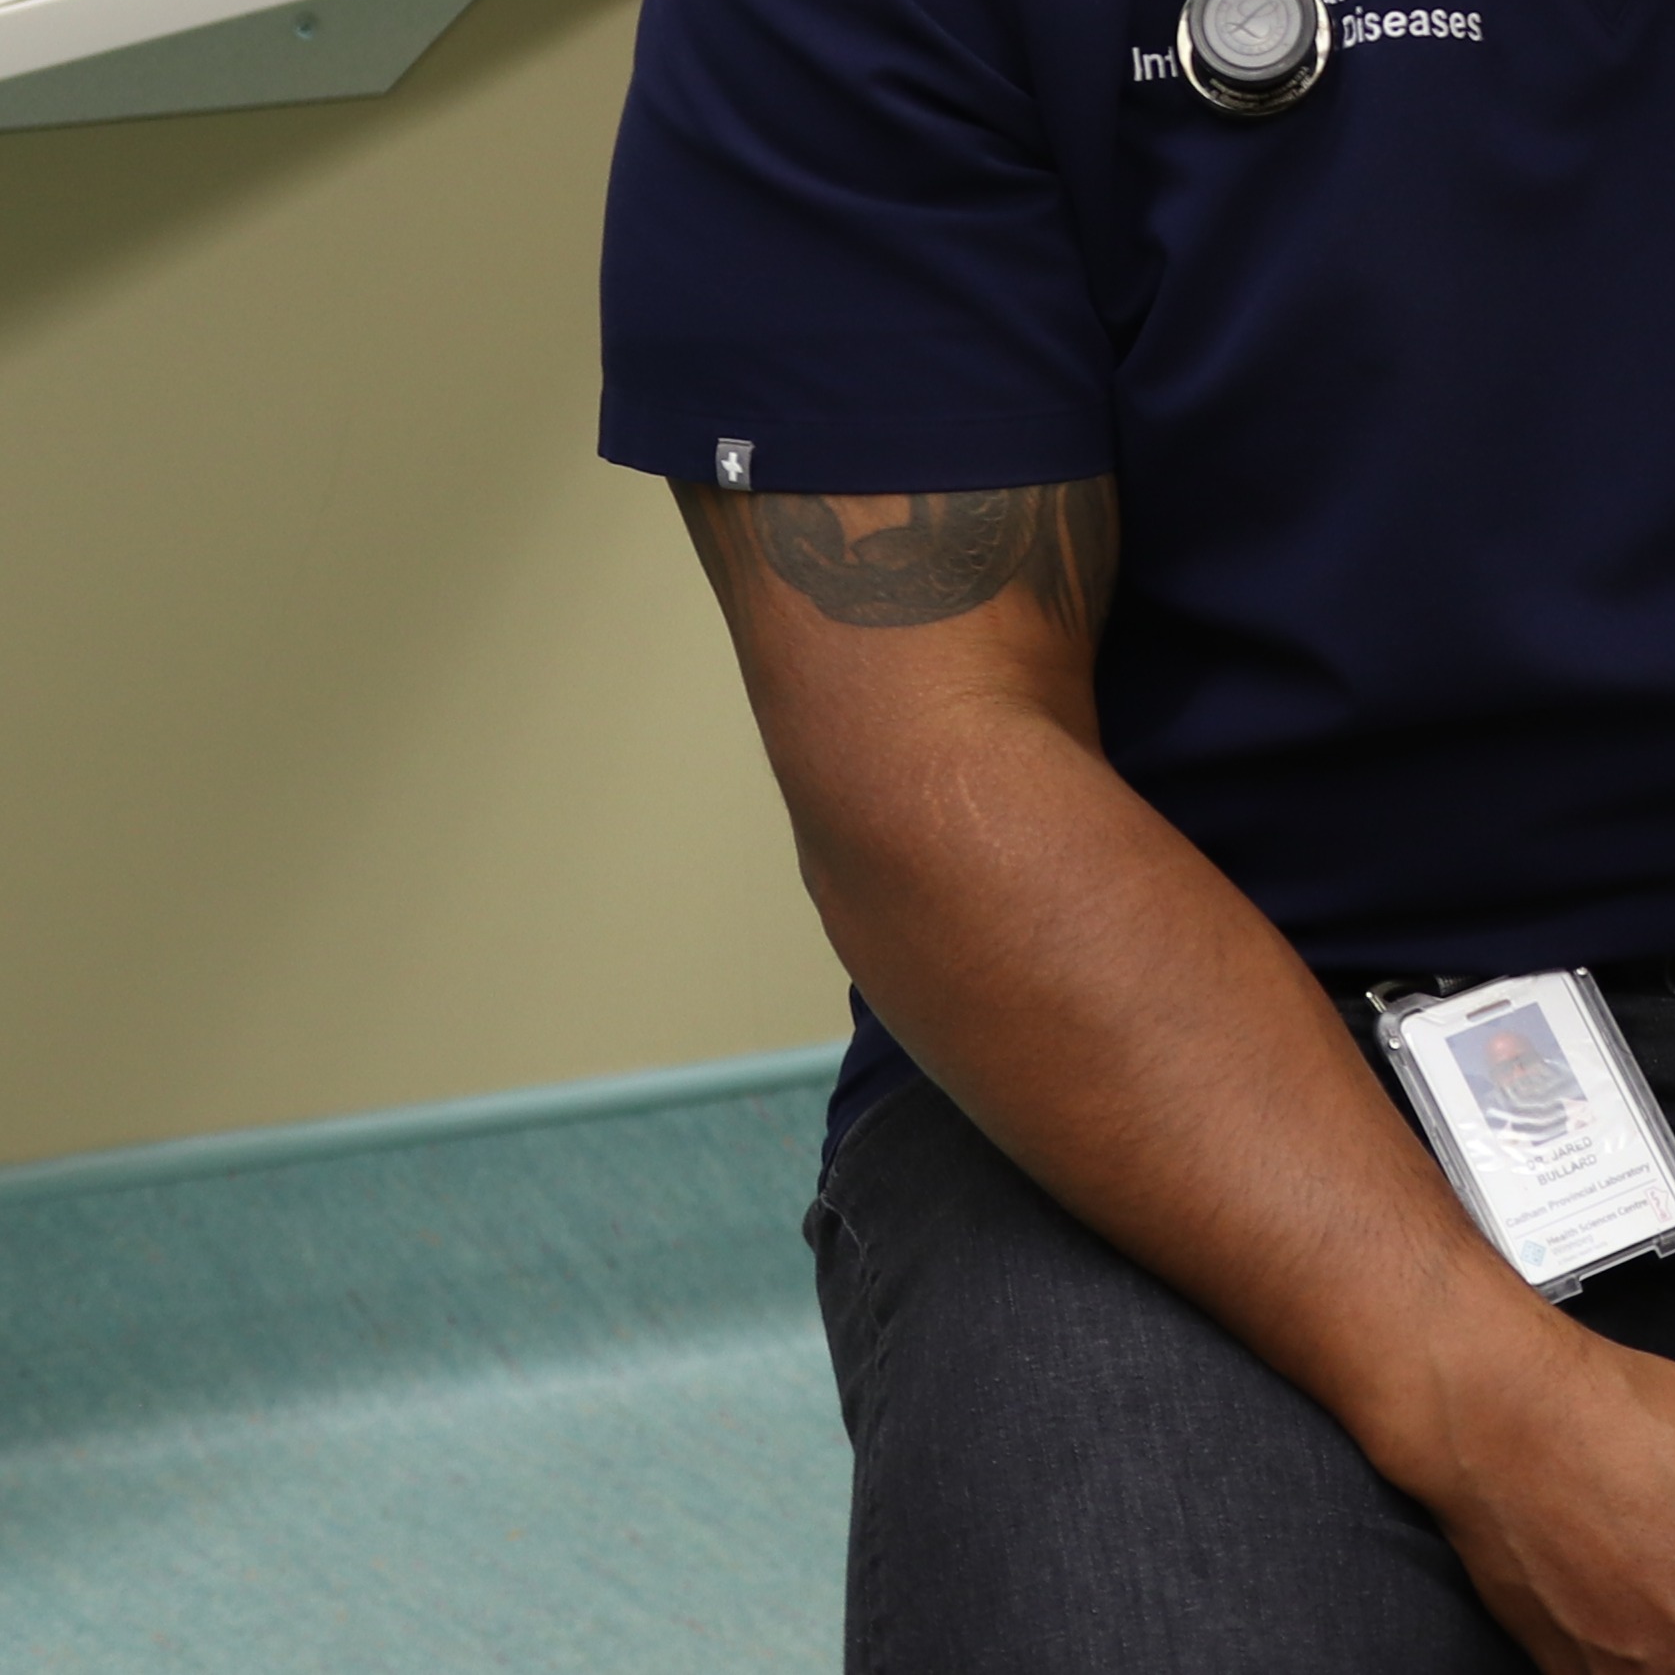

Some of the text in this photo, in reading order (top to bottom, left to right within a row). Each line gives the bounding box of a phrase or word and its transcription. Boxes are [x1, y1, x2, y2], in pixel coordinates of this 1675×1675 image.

[1341, 6, 1484, 49] Diseases
[1552, 1136, 1593, 1161] JARED
[1536, 1153, 1598, 1186] BULLARD
[1549, 1183, 1597, 1211] Provincial
[1599, 1163, 1651, 1189] Laboratory
[1546, 1226, 1579, 1245] Health
[1580, 1211, 1617, 1233] Sciences
